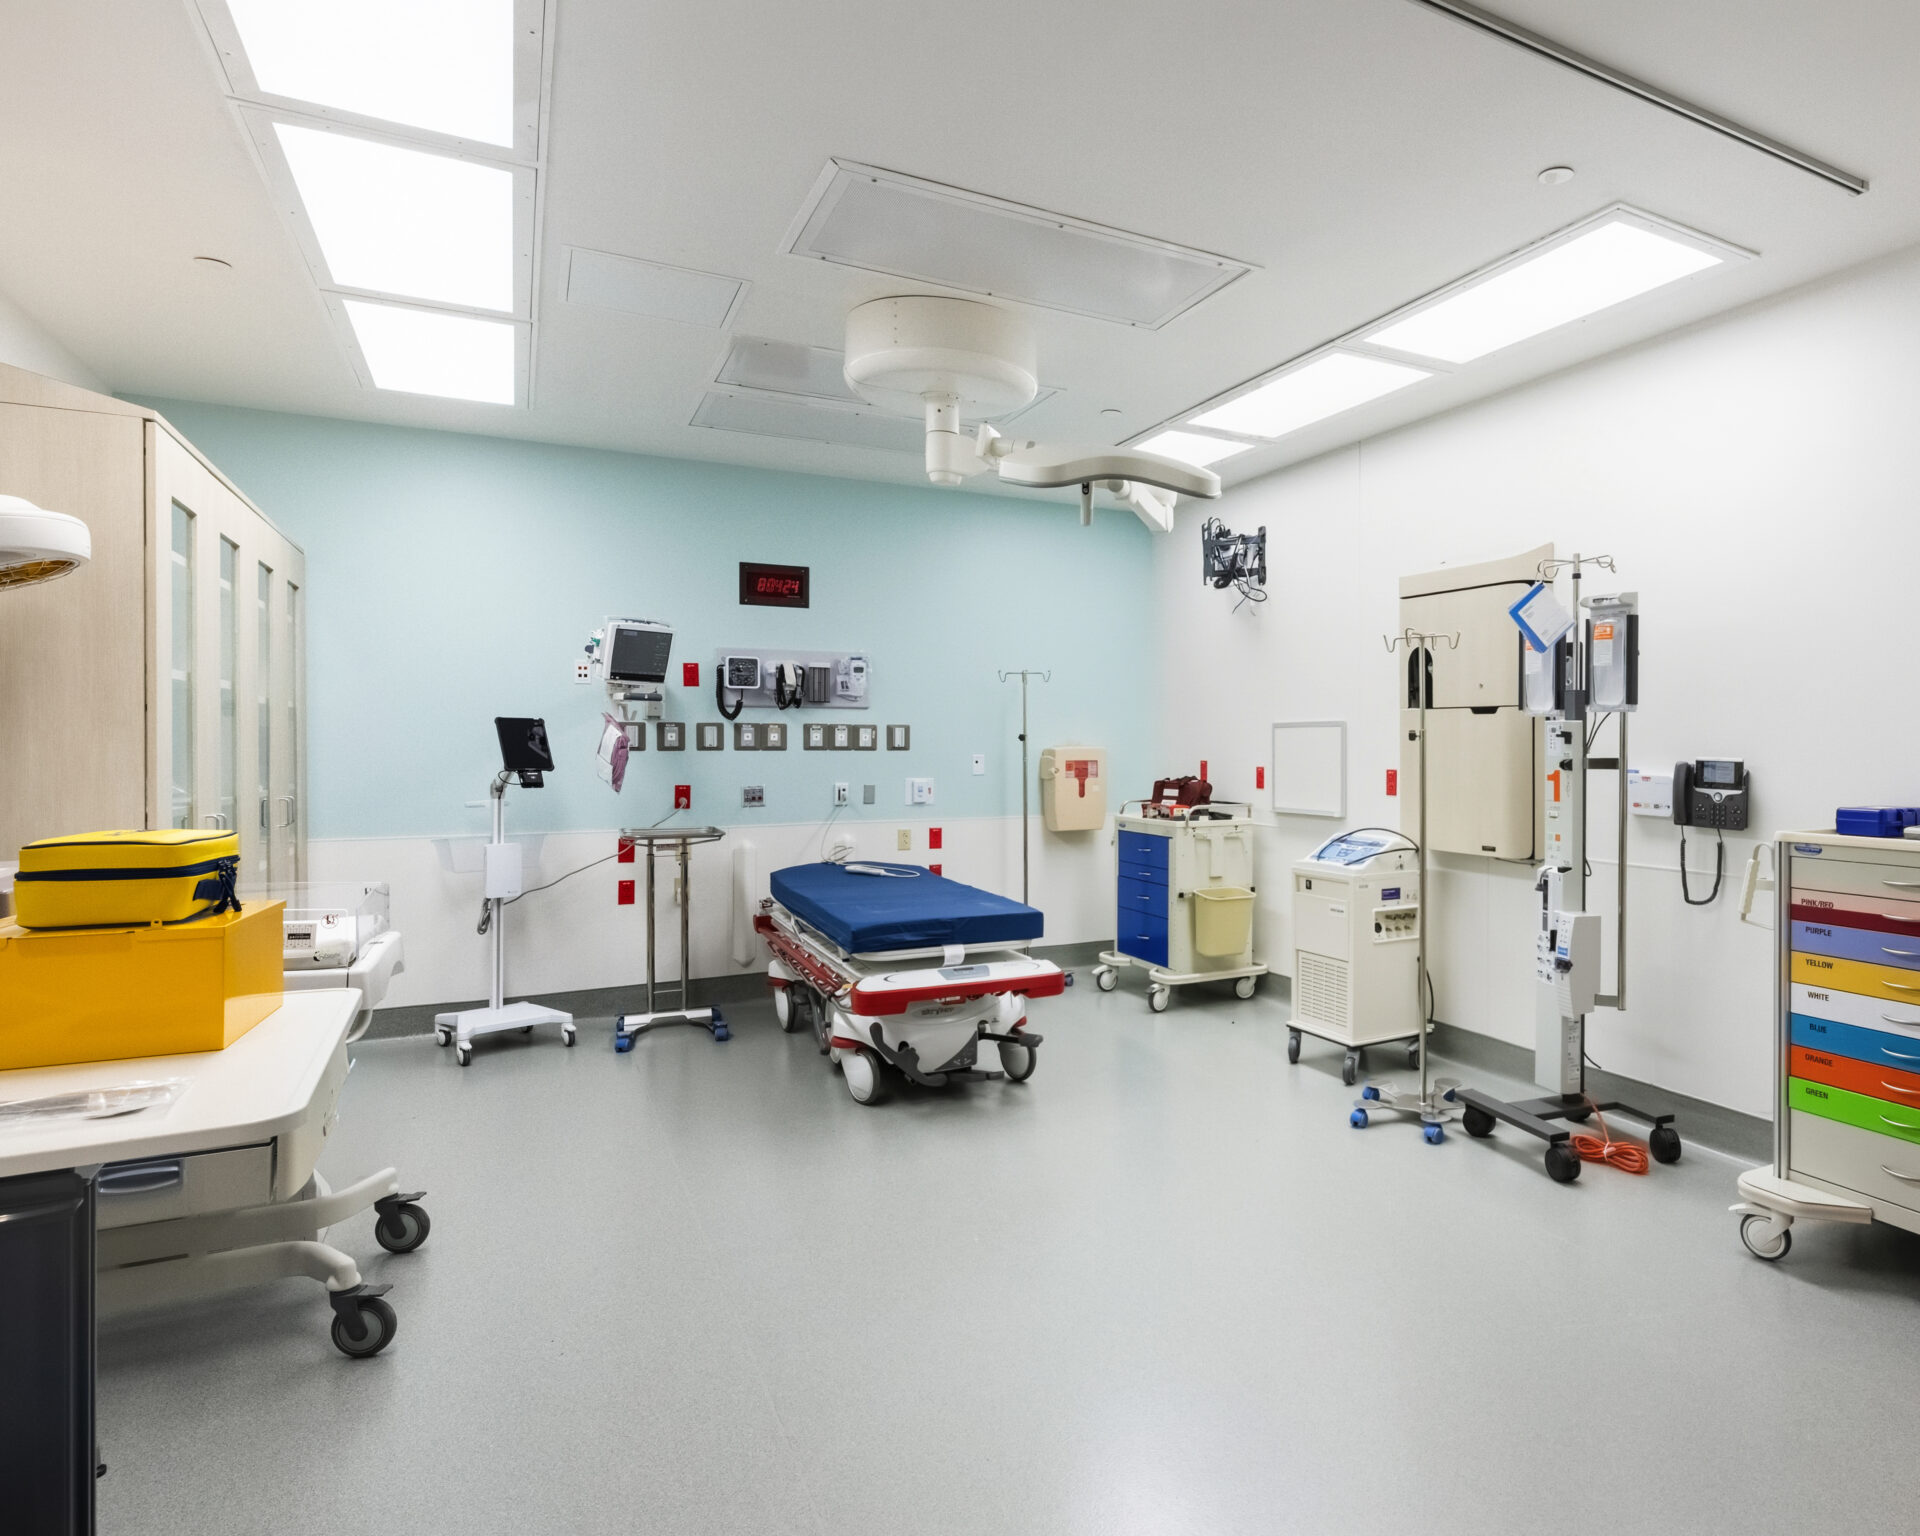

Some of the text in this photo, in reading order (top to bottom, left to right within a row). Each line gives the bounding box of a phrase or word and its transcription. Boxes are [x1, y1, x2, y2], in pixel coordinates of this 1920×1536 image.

[1547, 769, 1560, 802] 1
[1801, 898, 1834, 909] PINK/RED
[1805, 926, 1833, 937] PURPLE
[1805, 958, 1834, 970] YELLOW
[1807, 991, 1830, 1002] WHITE
[1809, 1023, 1828, 1034] BLUE
[1805, 1053, 1833, 1067] ORANGE
[1805, 1087, 1829, 1100] GREEN
